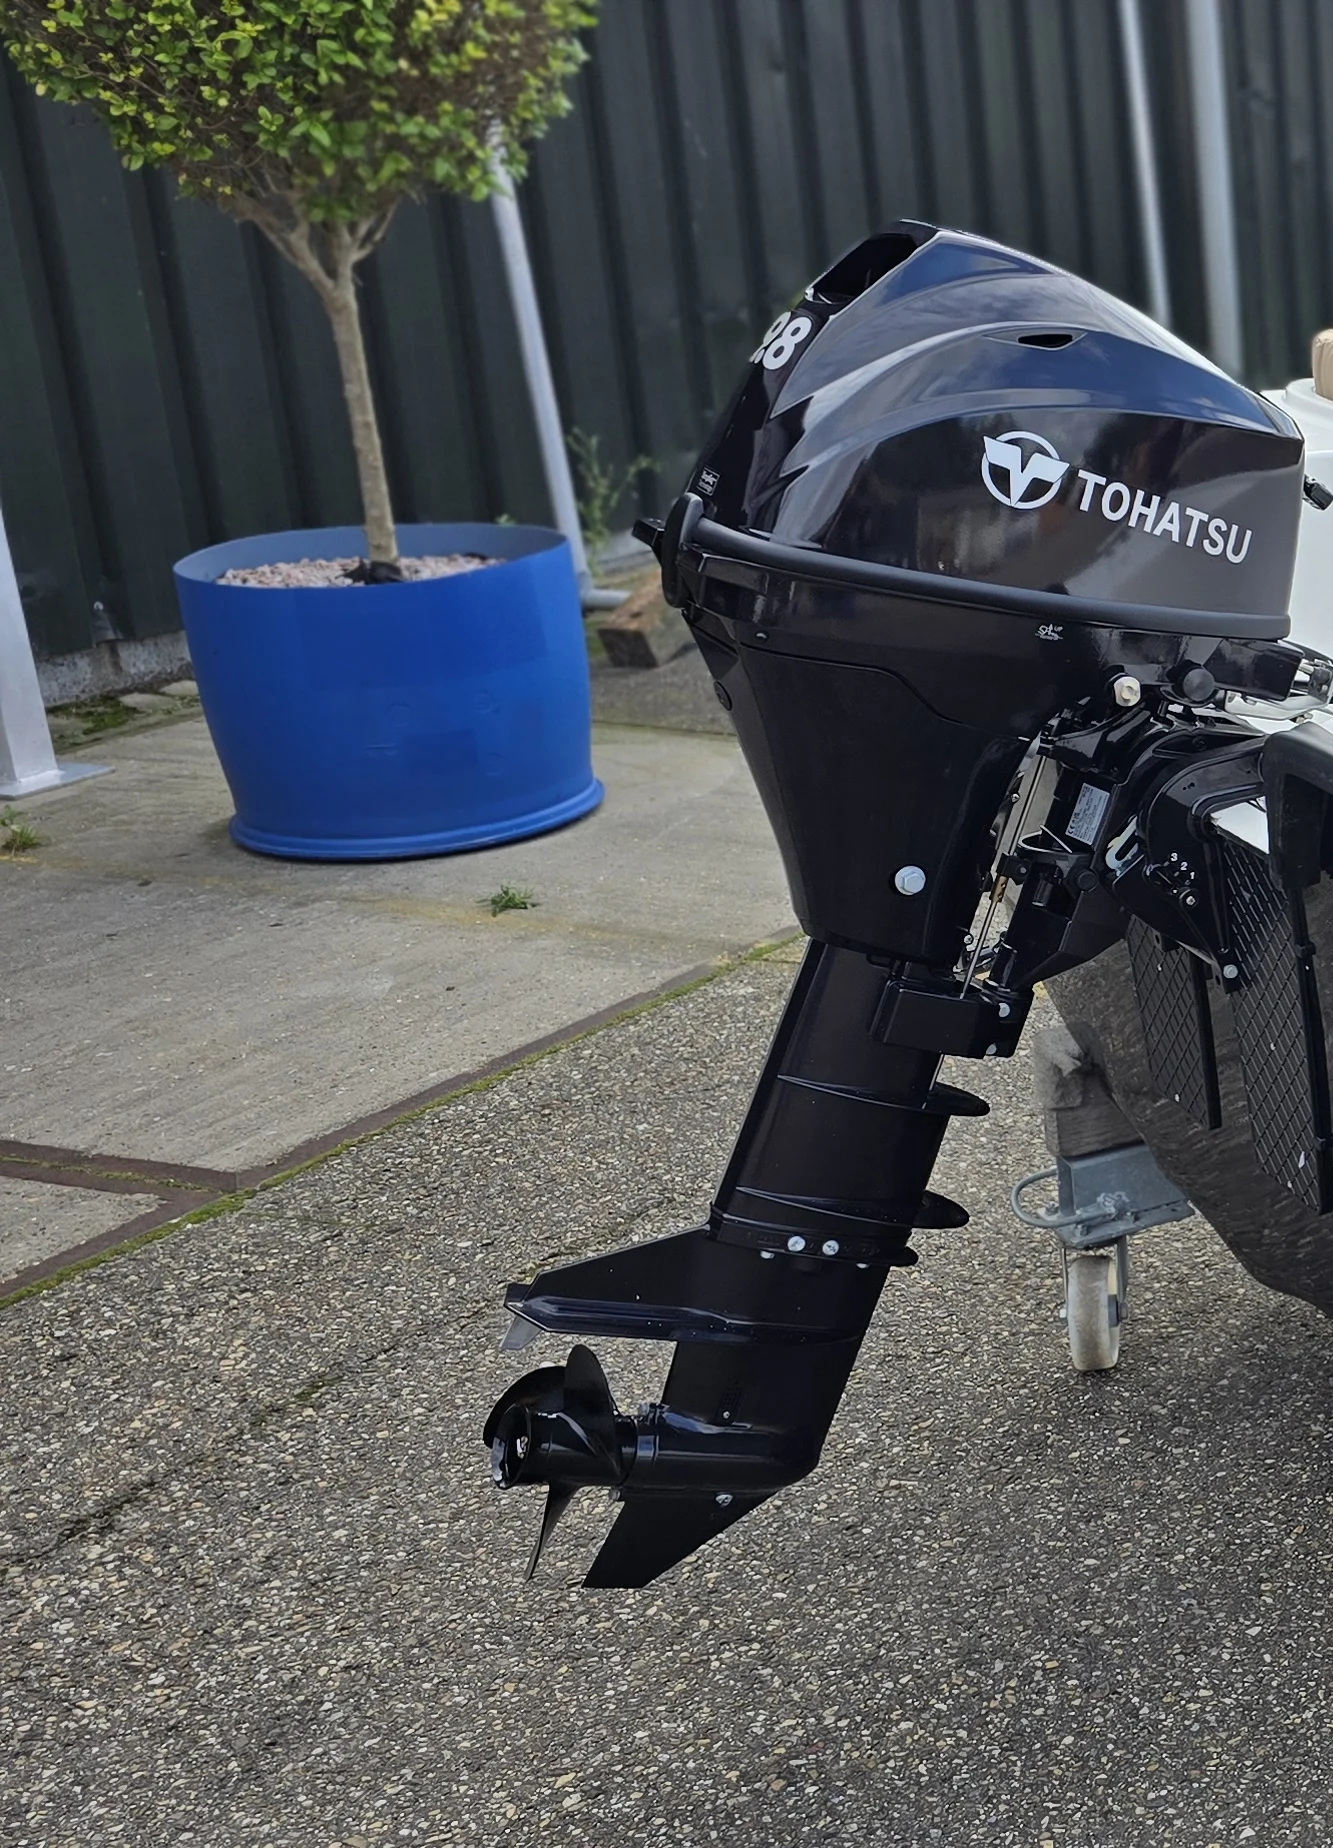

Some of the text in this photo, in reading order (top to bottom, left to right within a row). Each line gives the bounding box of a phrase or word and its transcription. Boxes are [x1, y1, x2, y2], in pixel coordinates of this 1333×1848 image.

[1077, 469, 1252, 564] TOHATSU
[1170, 852, 1178, 862] 3
[1180, 861, 1188, 871] 2
[1189, 871, 1195, 880] 1
